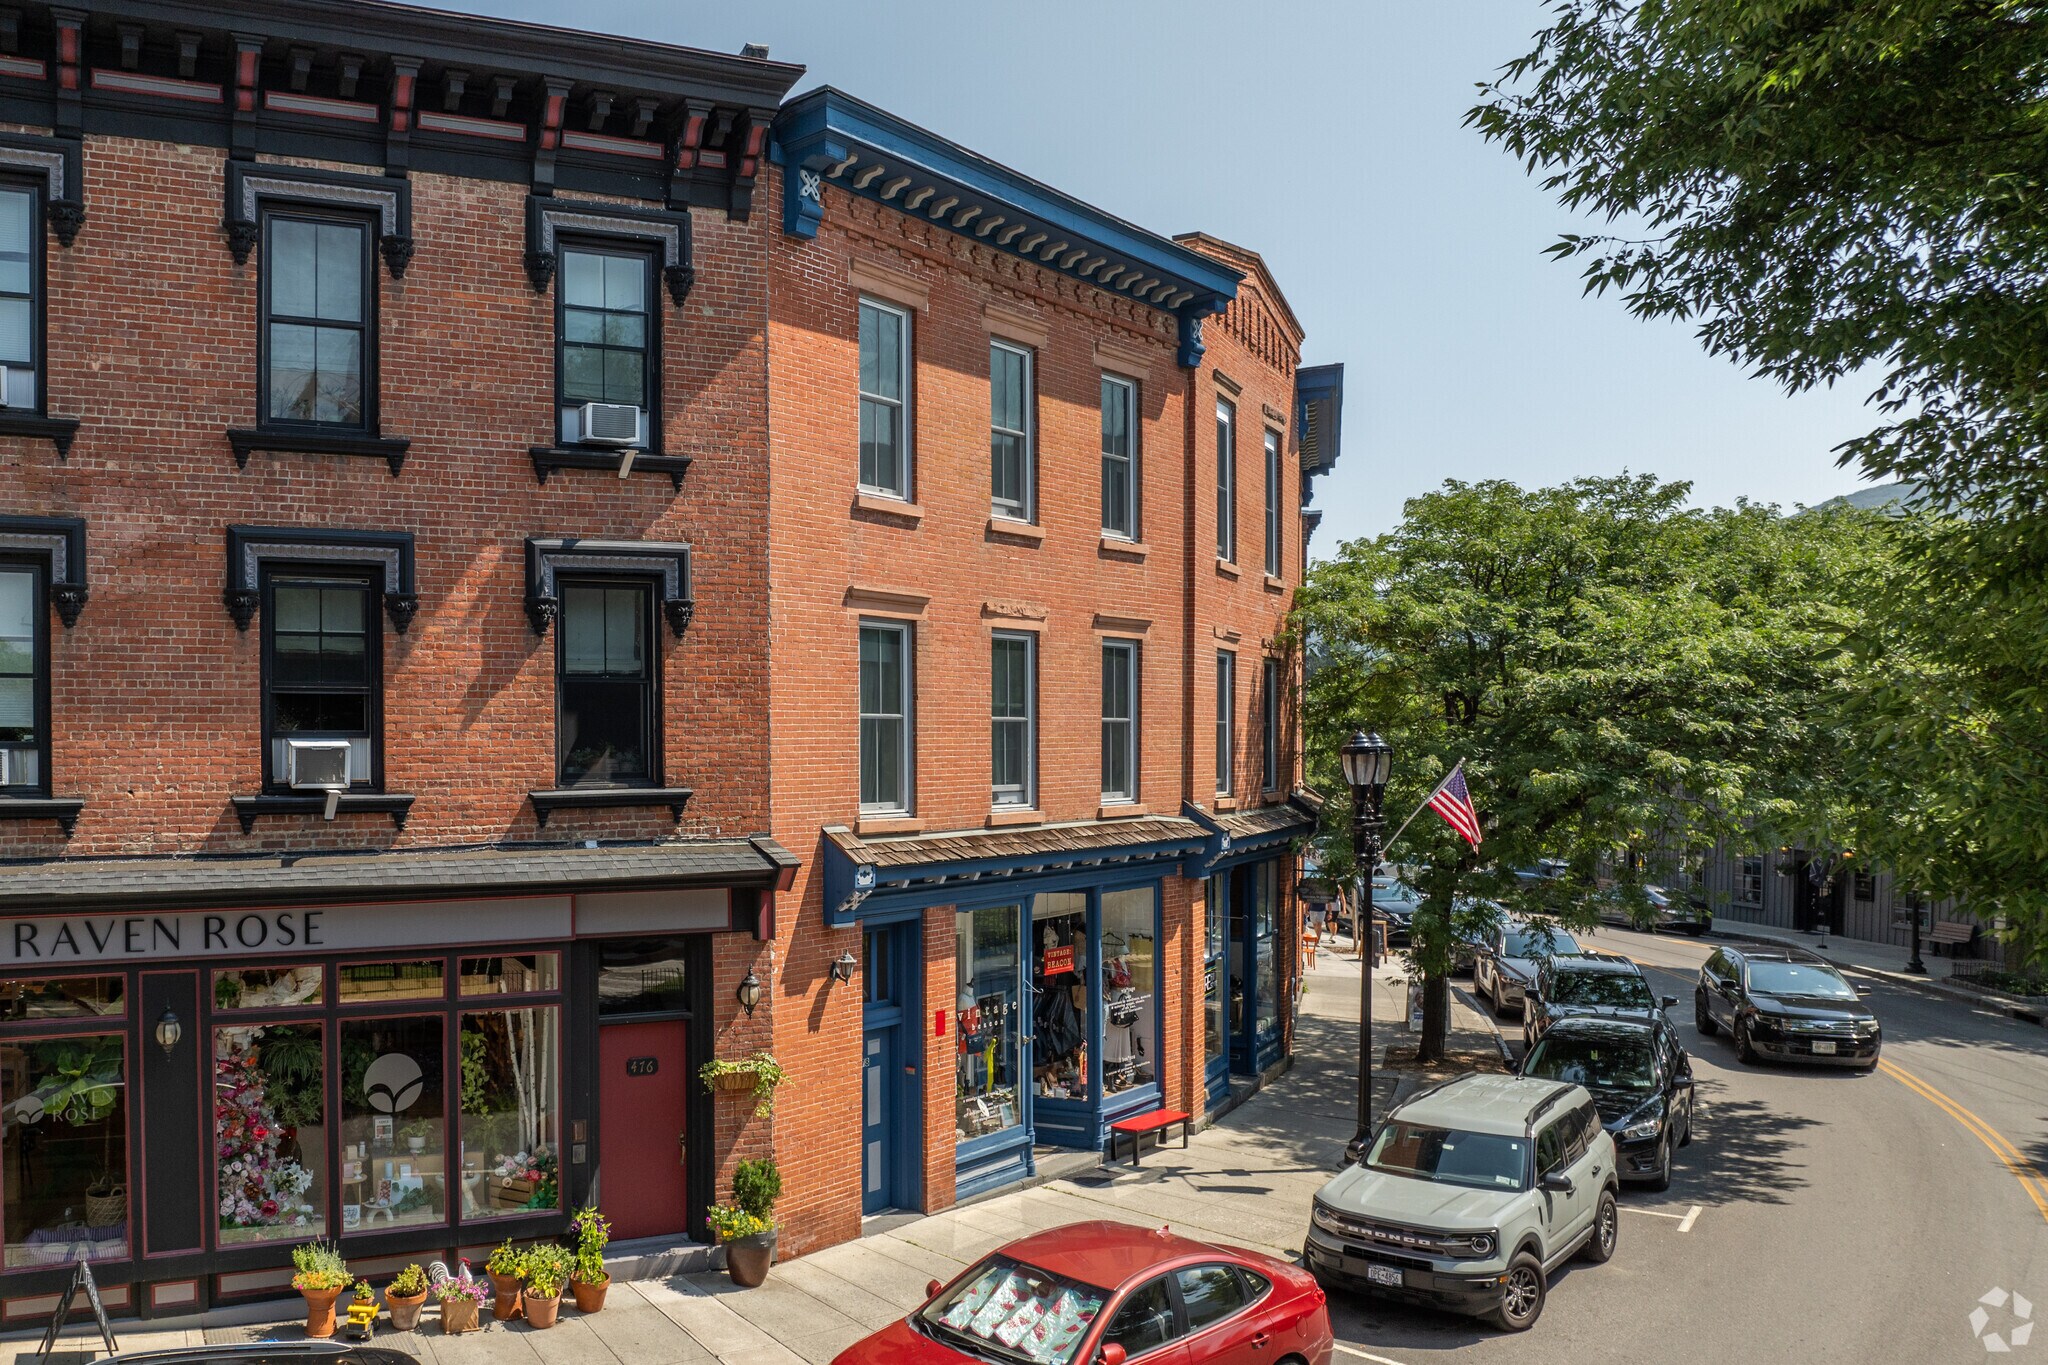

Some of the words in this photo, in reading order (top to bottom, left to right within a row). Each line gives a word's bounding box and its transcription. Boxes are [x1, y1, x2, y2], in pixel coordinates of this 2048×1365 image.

[14, 917, 181, 958] RAVEN
[203, 911, 324, 950] ROSE
[1047, 957, 1072, 969] BEACON
[957, 1001, 1018, 1022] vintage
[971, 1019, 1004, 1031] beacon
[631, 1061, 654, 1073] 476
[52, 1088, 115, 1106] RAVEN
[52, 1106, 101, 1122] ROSE
[1348, 1225, 1431, 1246] BRONCO
